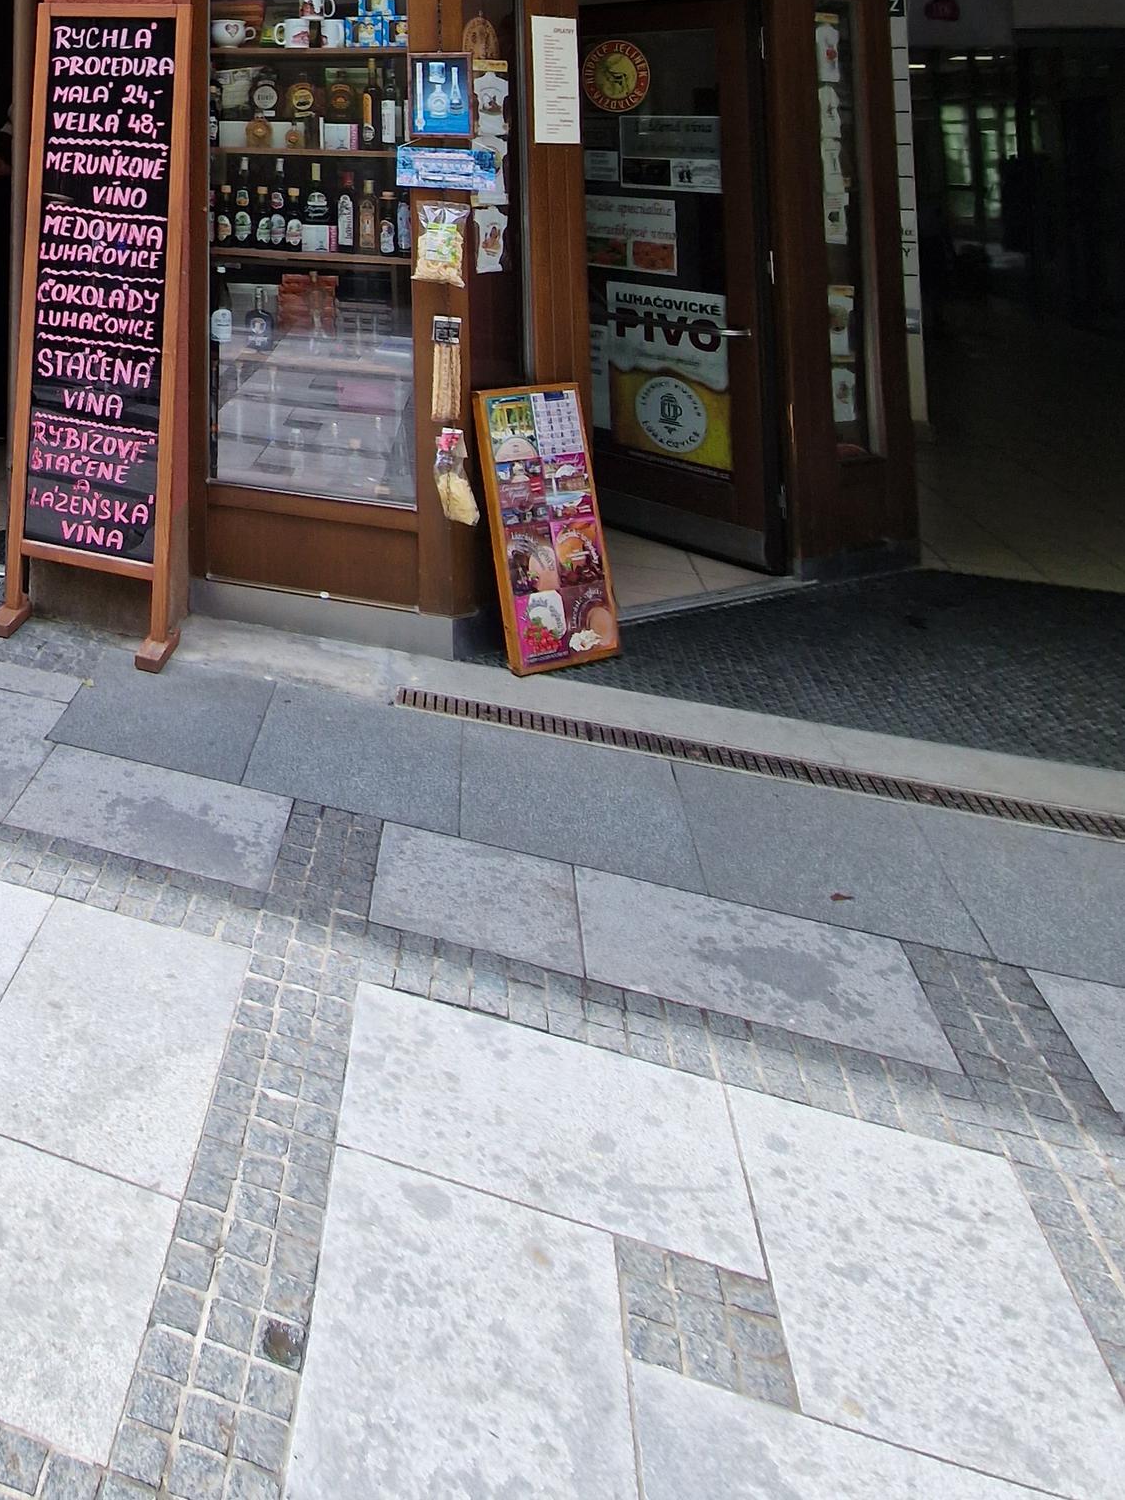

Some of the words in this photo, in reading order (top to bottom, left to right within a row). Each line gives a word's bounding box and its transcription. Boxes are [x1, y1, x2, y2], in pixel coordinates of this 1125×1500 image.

[53, 22, 158, 49] RYCHLÁ
[52, 56, 174, 77] PROCEDURA
[53, 81, 114, 103] MALÁ
[121, 84, 163, 109] 24,-
[53, 108, 123, 133] VELKÁ
[128, 114, 165, 139] 48,-
[46, 149, 167, 180] MERUŇKOVÉ
[92, 181, 147, 209] VÍNO
[43, 215, 163, 249] MEDOVINA
[39, 241, 163, 268] LUHAČOVICE
[37, 278, 159, 314] ČOKOLÁDY
[616, 291, 721, 316] LUHAČOVICKÉ
[38, 310, 155, 340] LUHAČOVICE
[616, 307, 722, 353] PIVO
[38, 347, 156, 388] STÁČENÁ
[63, 386, 124, 419] VÍNA
[32, 420, 155, 463] RYBÍZOVÉ
[29, 485, 154, 525] LÁZEŇSKÁ
[61, 519, 124, 550] VÍNA
